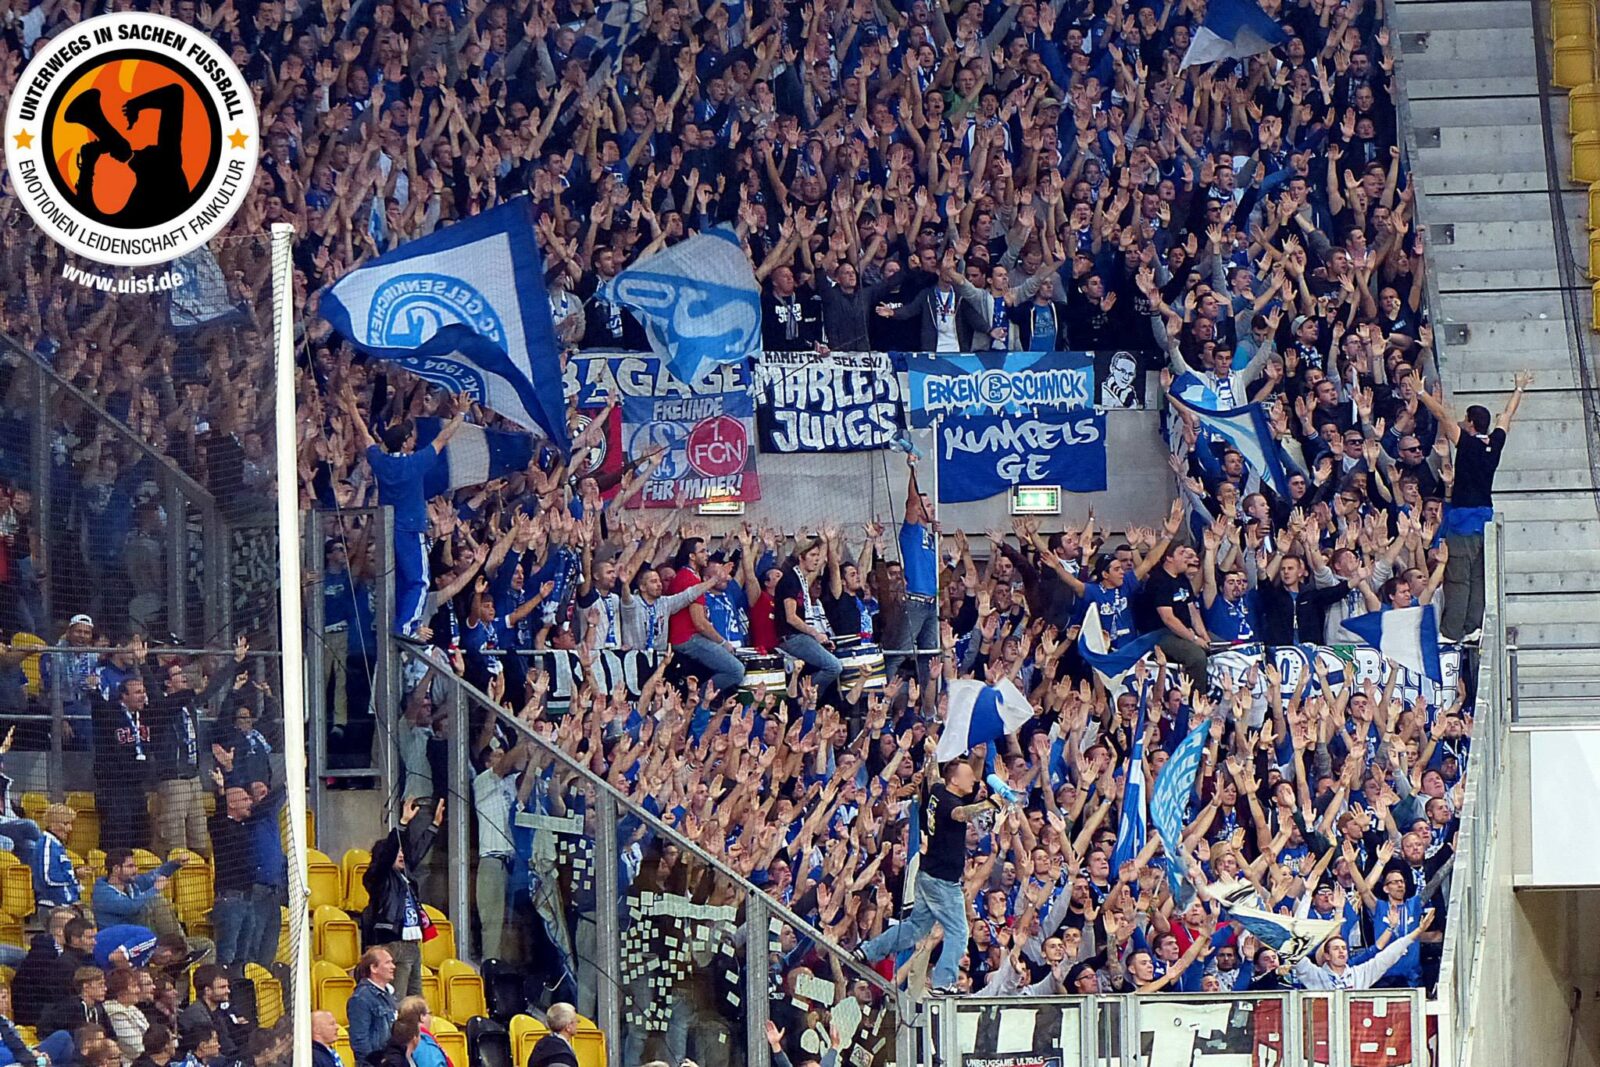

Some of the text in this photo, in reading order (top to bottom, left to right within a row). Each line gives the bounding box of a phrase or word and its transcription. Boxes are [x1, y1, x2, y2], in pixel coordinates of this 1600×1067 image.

[755, 362, 899, 411] MARLER
[927, 370, 1084, 403] ERKEN SCHWICK
[653, 397, 723, 420] FREUNDE
[710, 421, 723, 441] 1.
[772, 403, 898, 452] JUNGS
[944, 418, 1099, 460] KUMPELS
[694, 440, 743, 464] FCN
[996, 453, 1051, 484] GE
[642, 474, 743, 500] FÜR IMMER!
